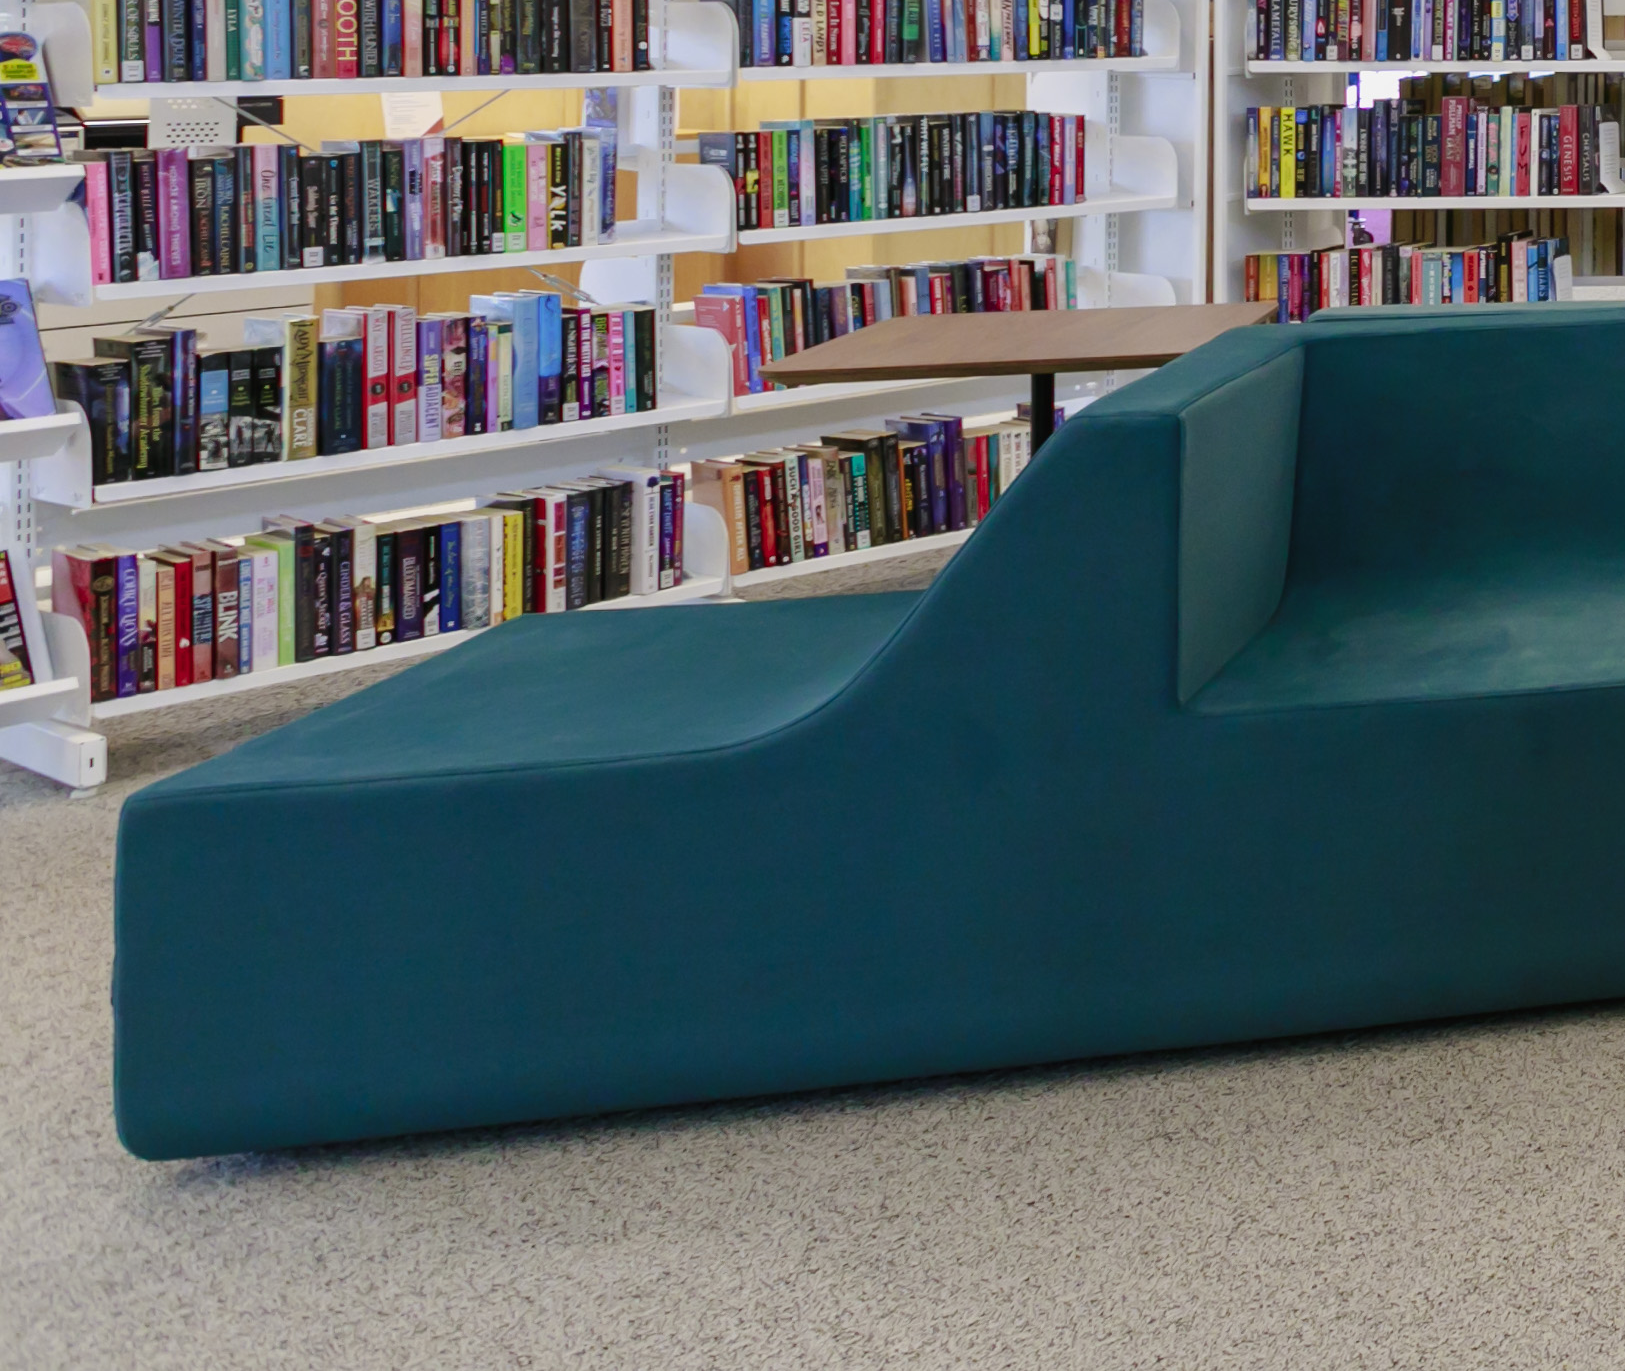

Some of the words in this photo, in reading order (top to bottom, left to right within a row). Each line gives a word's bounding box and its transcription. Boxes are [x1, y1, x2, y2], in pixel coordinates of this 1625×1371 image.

[126, 8, 138, 22] OF
[228, 9, 237, 31] LYLA
[830, 1, 839, 17] Let
[127, 26, 138, 60] SOULS
[802, 21, 810, 42] LEIA
[816, 21, 824, 53] LANDS
[169, 38, 185, 65] DUKE
[364, 30, 377, 65] HUNTER
[1448, 99, 1456, 135] PULLMAN
[1283, 114, 1293, 156] HAWK
[195, 177, 208, 208] IRON
[261, 169, 277, 191] One
[262, 197, 276, 228] Great
[368, 178, 380, 230] WAKERS
[171, 233, 181, 265] THIEVES
[263, 234, 276, 253] Lie
[291, 321, 314, 351] LADY
[398, 311, 415, 371] SPELLSLINGER
[372, 345, 384, 372] ARGOSI
[424, 354, 438, 384] SUPER
[293, 351, 314, 402] MIDNIGHT
[425, 387, 440, 429] ADJACENT
[293, 409, 307, 449] CLARE
[136, 429, 151, 468] Academy
[788, 466, 797, 490] SUCH
[735, 521, 744, 545] AFTER
[791, 506, 800, 532] GOOD
[736, 547, 744, 561] ALL
[793, 535, 801, 555] GIRL
[120, 569, 137, 607] COURT
[339, 561, 350, 600] CINDER
[403, 557, 417, 619] BLOODMARKED
[218, 591, 237, 643] BLINK
[340, 613, 350, 643] GLASS
